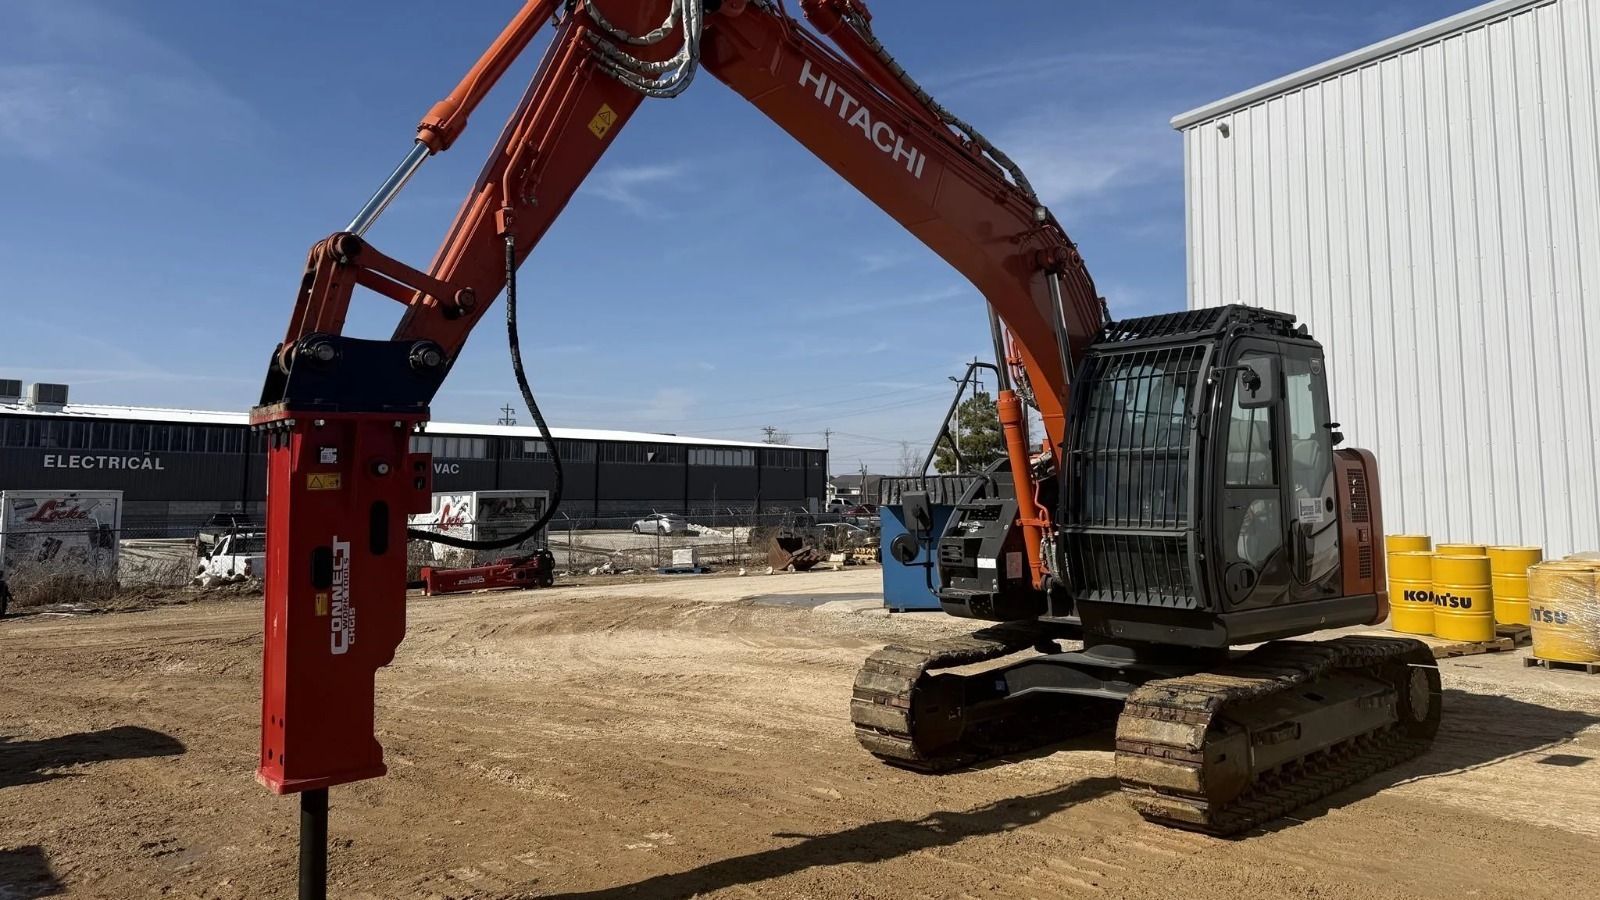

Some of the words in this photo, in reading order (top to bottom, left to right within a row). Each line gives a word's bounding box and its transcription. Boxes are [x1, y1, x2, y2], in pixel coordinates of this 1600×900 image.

[799, 59, 926, 179] HITACHI
[43, 454, 165, 470] ELECTRICAL
[330, 535, 351, 655] CONNECT
